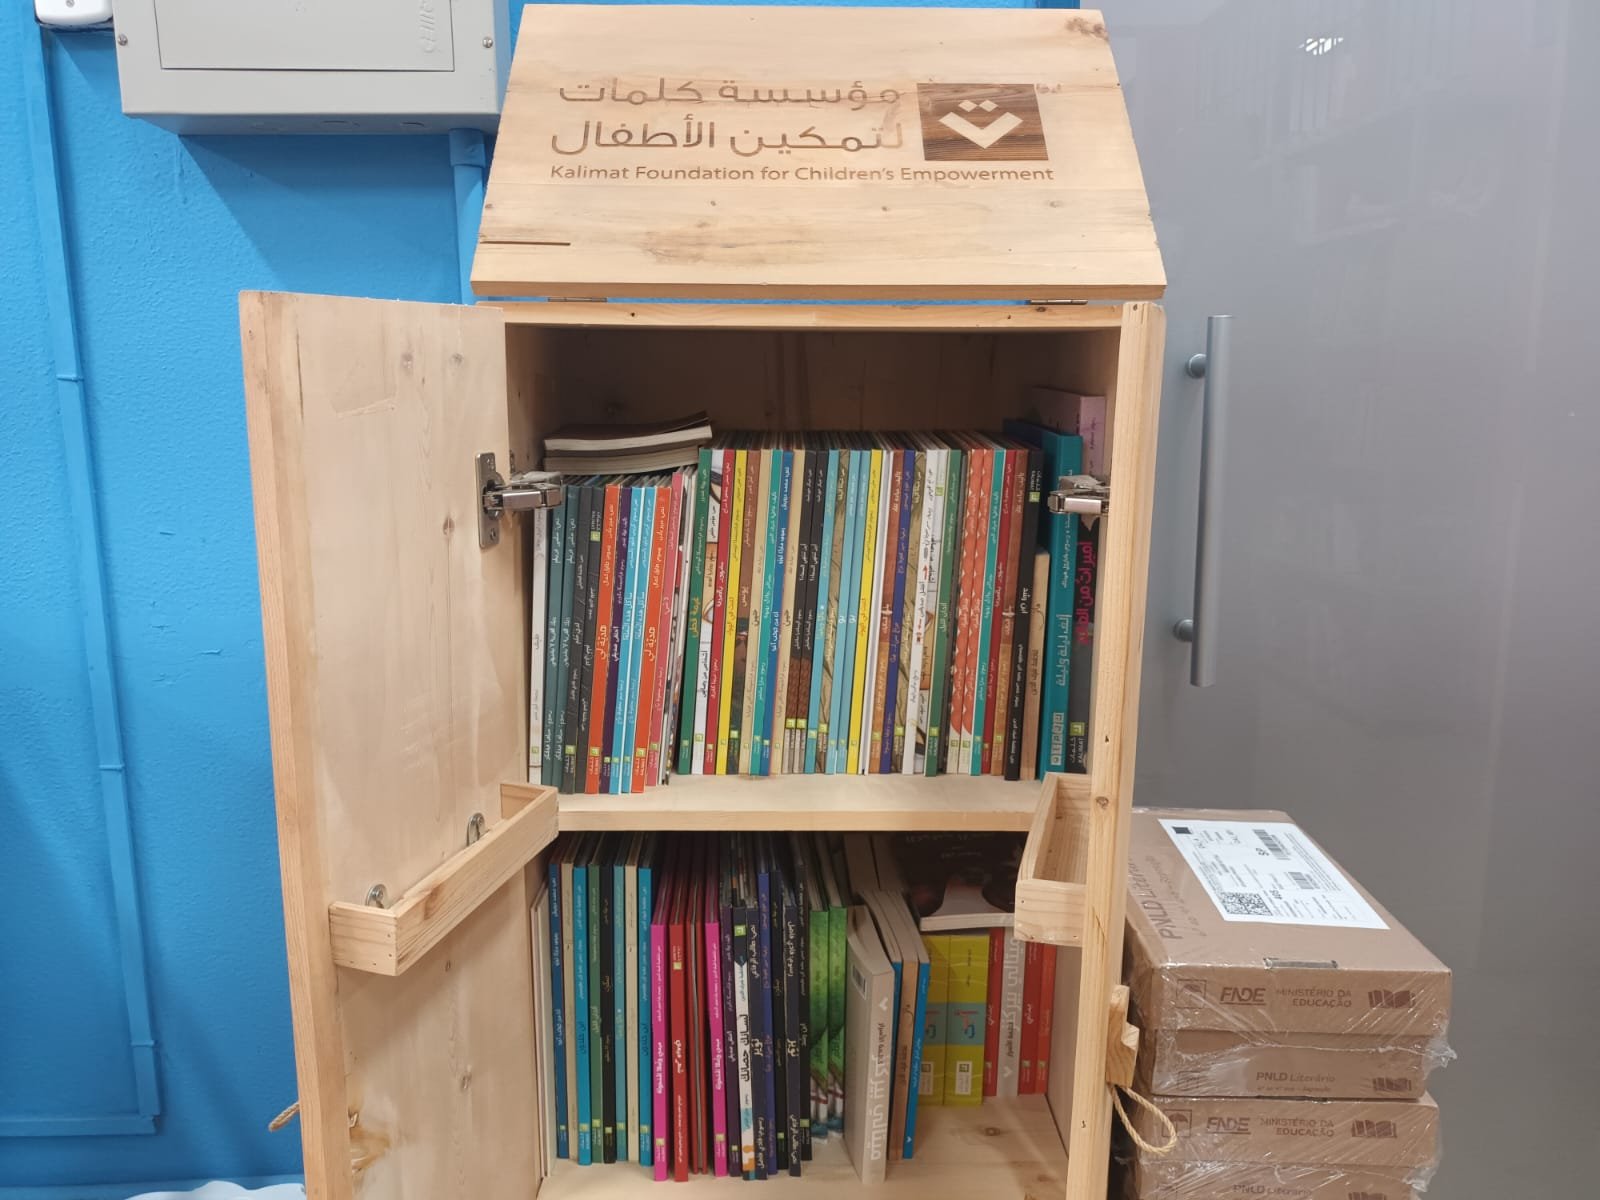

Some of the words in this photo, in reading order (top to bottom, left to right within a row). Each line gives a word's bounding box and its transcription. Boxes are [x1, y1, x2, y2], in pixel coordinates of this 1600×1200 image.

[559, 77, 704, 105] كلمات
[718, 80, 900, 111] مؤسسة
[551, 113, 715, 156] الأطفال
[729, 123, 903, 157] لتمكين
[551, 165, 629, 180] Kalimat
[635, 165, 754, 180] Foundation
[761, 165, 790, 180] for
[900, 166, 1054, 184] Empowerment
[1056, 635, 1070, 656] ليلة
[1055, 658, 1070, 686] وليلة
[1141, 900, 1184, 939] PNLD
[750, 958, 760, 977] الرفاعي
[1220, 987, 1267, 1001] FNDE
[1276, 987, 1335, 997] MINISTÉRIO
[1337, 988, 1352, 997] DA
[1292, 997, 1352, 1009] EDUCAÇÃO
[1256, 1072, 1288, 1081] PNLD
[1289, 1072, 1336, 1082] Literário
[1206, 1117, 1250, 1132] FNDE
[1260, 1116, 1318, 1127] MINISTÉRIO
[1320, 1119, 1334, 1127] DA
[1276, 1128, 1335, 1138] EDUCAÇÃO
[757, 1138, 765, 1151] فادي
[757, 1153, 765, 1168] فاضل
[1233, 1184, 1265, 1195] PNLD
